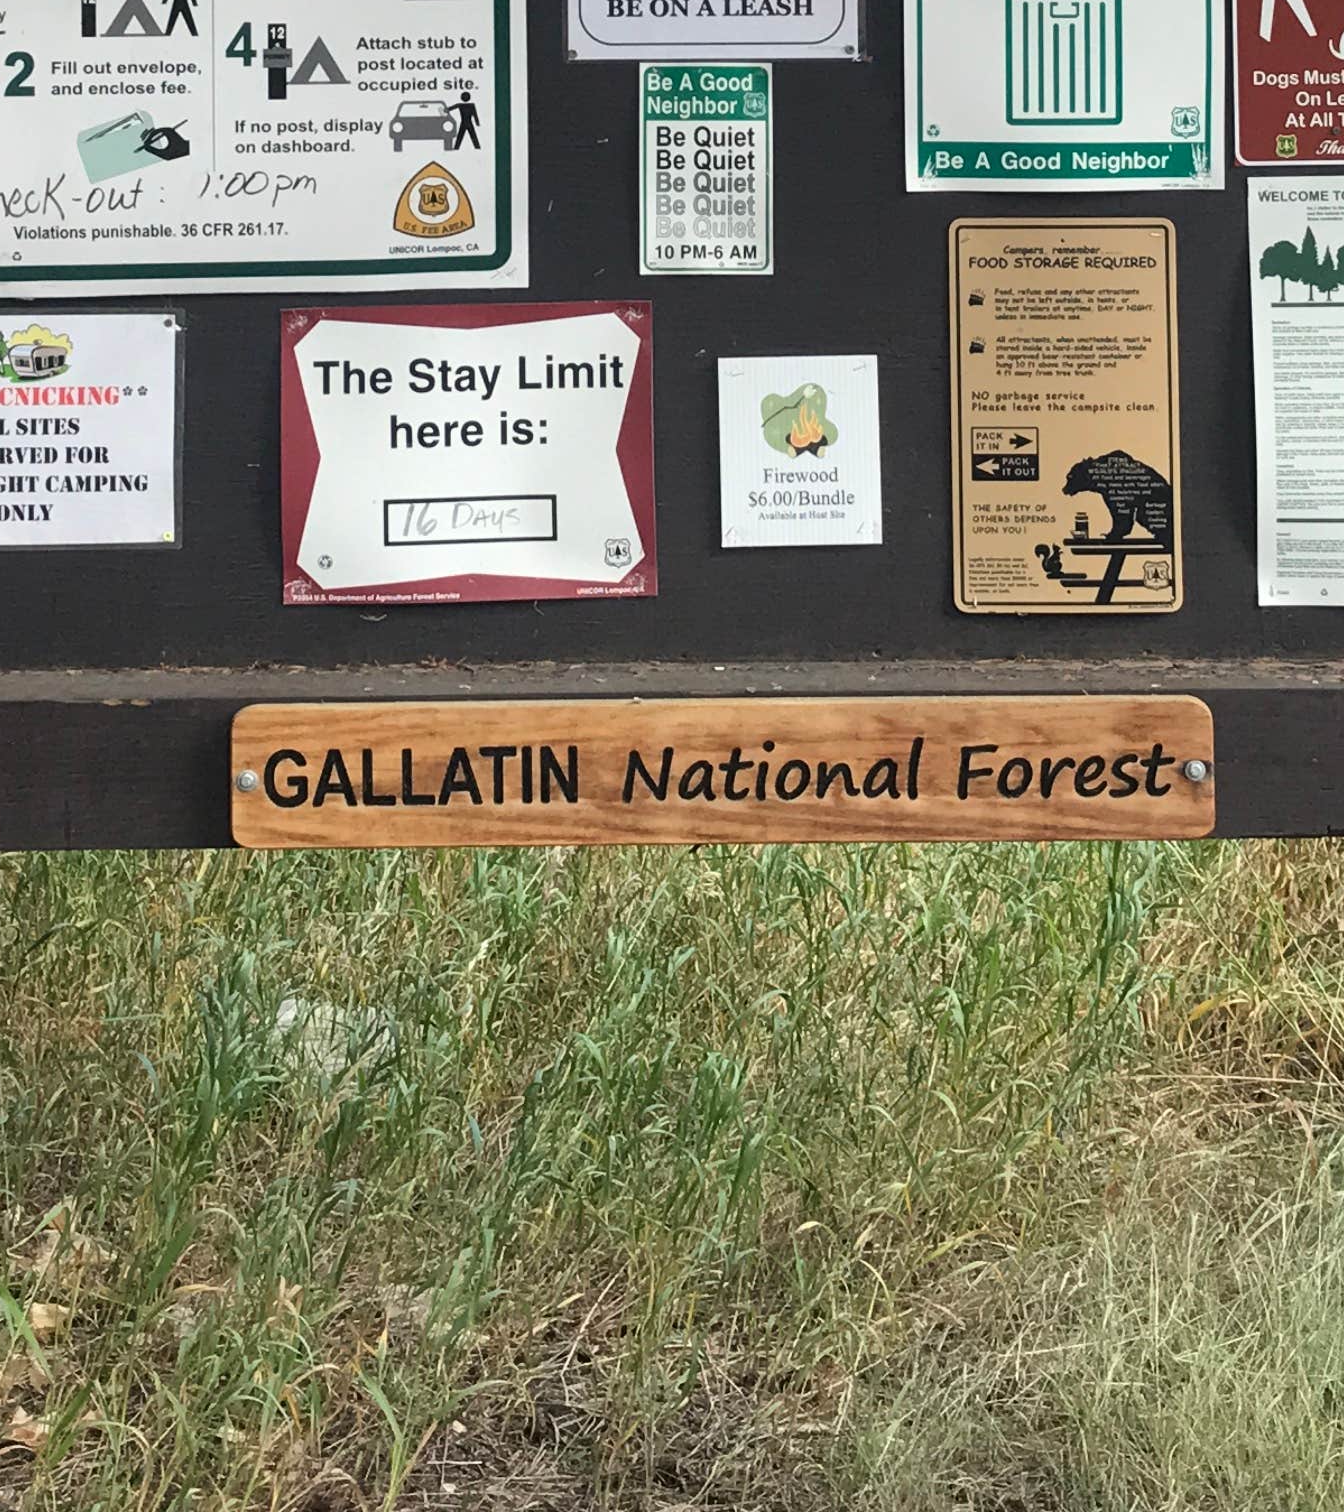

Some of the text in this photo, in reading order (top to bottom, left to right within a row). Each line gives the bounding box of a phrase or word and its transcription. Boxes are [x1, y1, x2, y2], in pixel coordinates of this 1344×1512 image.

[607, 0, 643, 17] BE
[647, 73, 754, 92] Be A Good
[1254, 71, 1299, 89] Dogs
[647, 94, 738, 118] Neighbor
[1296, 92, 1321, 106] On
[1285, 113, 1305, 127] At
[1310, 112, 1333, 127] All
[657, 126, 755, 149] Be Quiet
[657, 150, 755, 172] Be Quiet
[936, 151, 1169, 173] Be A Good Neighbor
[1258, 190, 1329, 202] WELCOME
[14, 226, 86, 239] Violations
[181, 223, 198, 237] 36
[202, 223, 234, 237] CFR
[656, 245, 757, 259] 10 PM-6 AM
[969, 256, 1156, 270] FOOD STORAGE REQUIRED
[313, 353, 625, 400] The Stay Limit
[972, 391, 1084, 403] NO garbage service
[16, 418, 79, 435] SITES
[391, 415, 483, 448] here
[66, 447, 109, 463] FOR
[46, 475, 147, 492] CAMPING
[763, 467, 838, 483] Firewood
[749, 490, 854, 507] $6.00/Bundle
[264, 738, 1175, 808] GALLATIN National Forest
